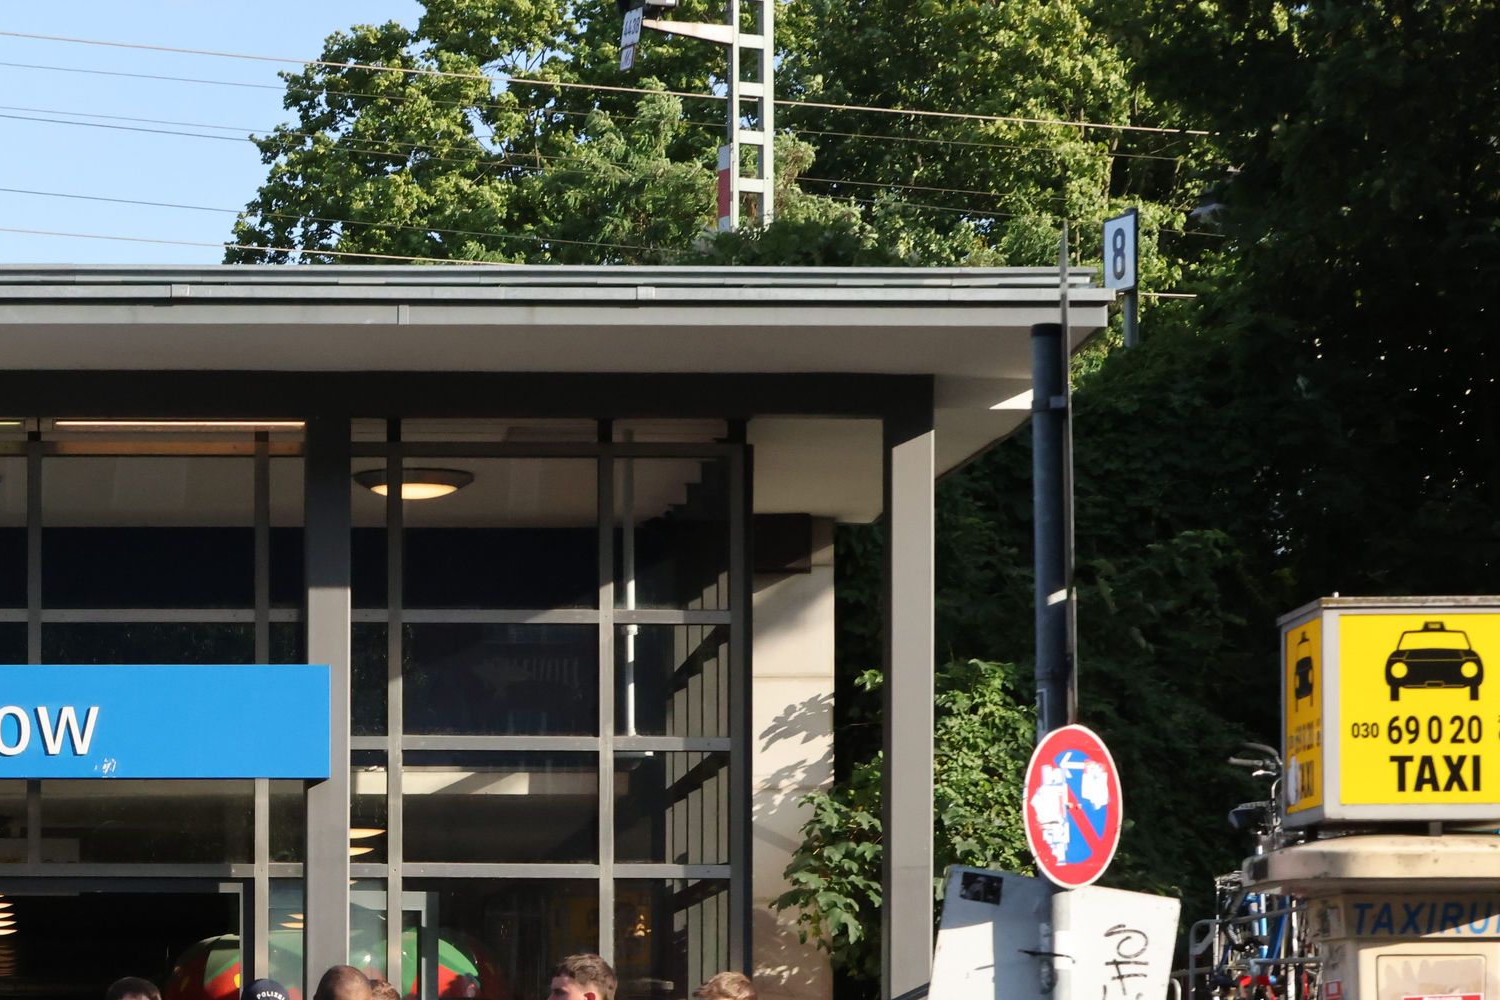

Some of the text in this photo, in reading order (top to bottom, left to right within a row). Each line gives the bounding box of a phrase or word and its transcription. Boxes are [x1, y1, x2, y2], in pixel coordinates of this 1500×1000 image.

[1112, 227, 1126, 281] 8
[1351, 722, 1379, 739] 030
[1389, 754, 1482, 793] TAXI
[1351, 902, 1500, 936] TAXIRU
